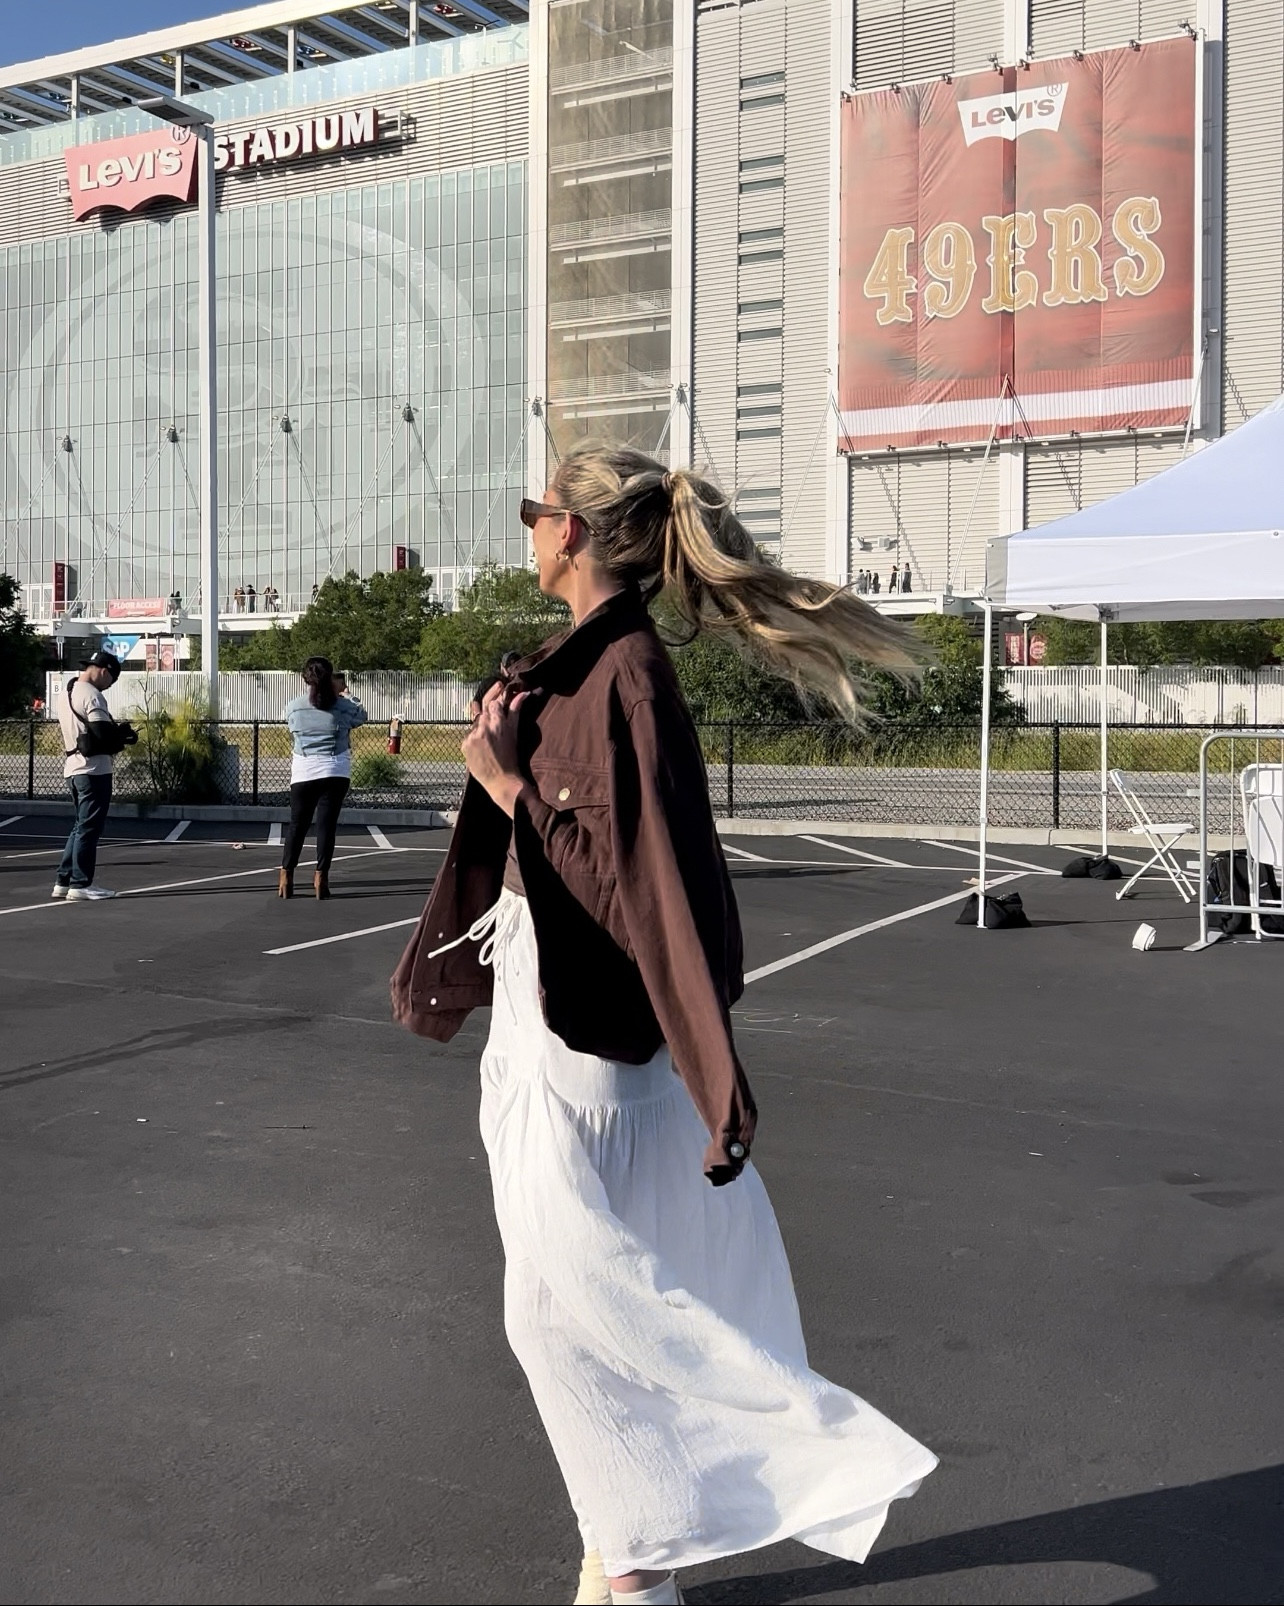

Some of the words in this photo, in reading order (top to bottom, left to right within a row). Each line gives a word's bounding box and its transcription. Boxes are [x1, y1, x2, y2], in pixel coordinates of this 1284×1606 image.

[213, 107, 378, 170] STADIUM
[863, 196, 1166, 326] 49ERS
[102, 641, 130, 658] SAP
